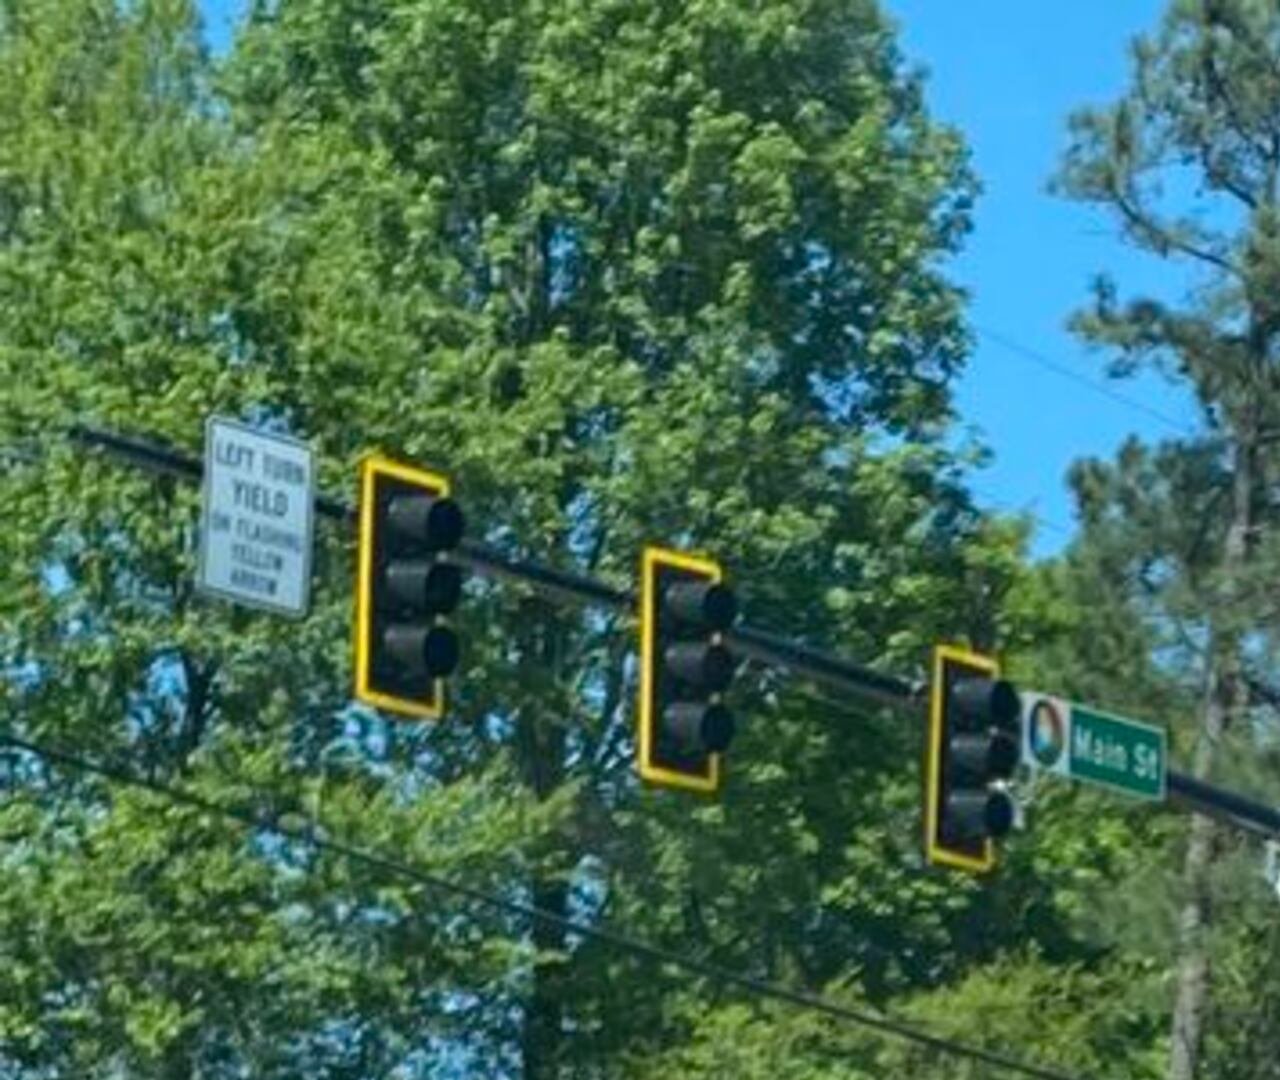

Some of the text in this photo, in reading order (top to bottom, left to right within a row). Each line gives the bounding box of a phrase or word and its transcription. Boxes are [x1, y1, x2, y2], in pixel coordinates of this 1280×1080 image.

[215, 438, 254, 473] LEFT
[233, 479, 289, 517] YIELD
[1073, 724, 1158, 781] Main St
